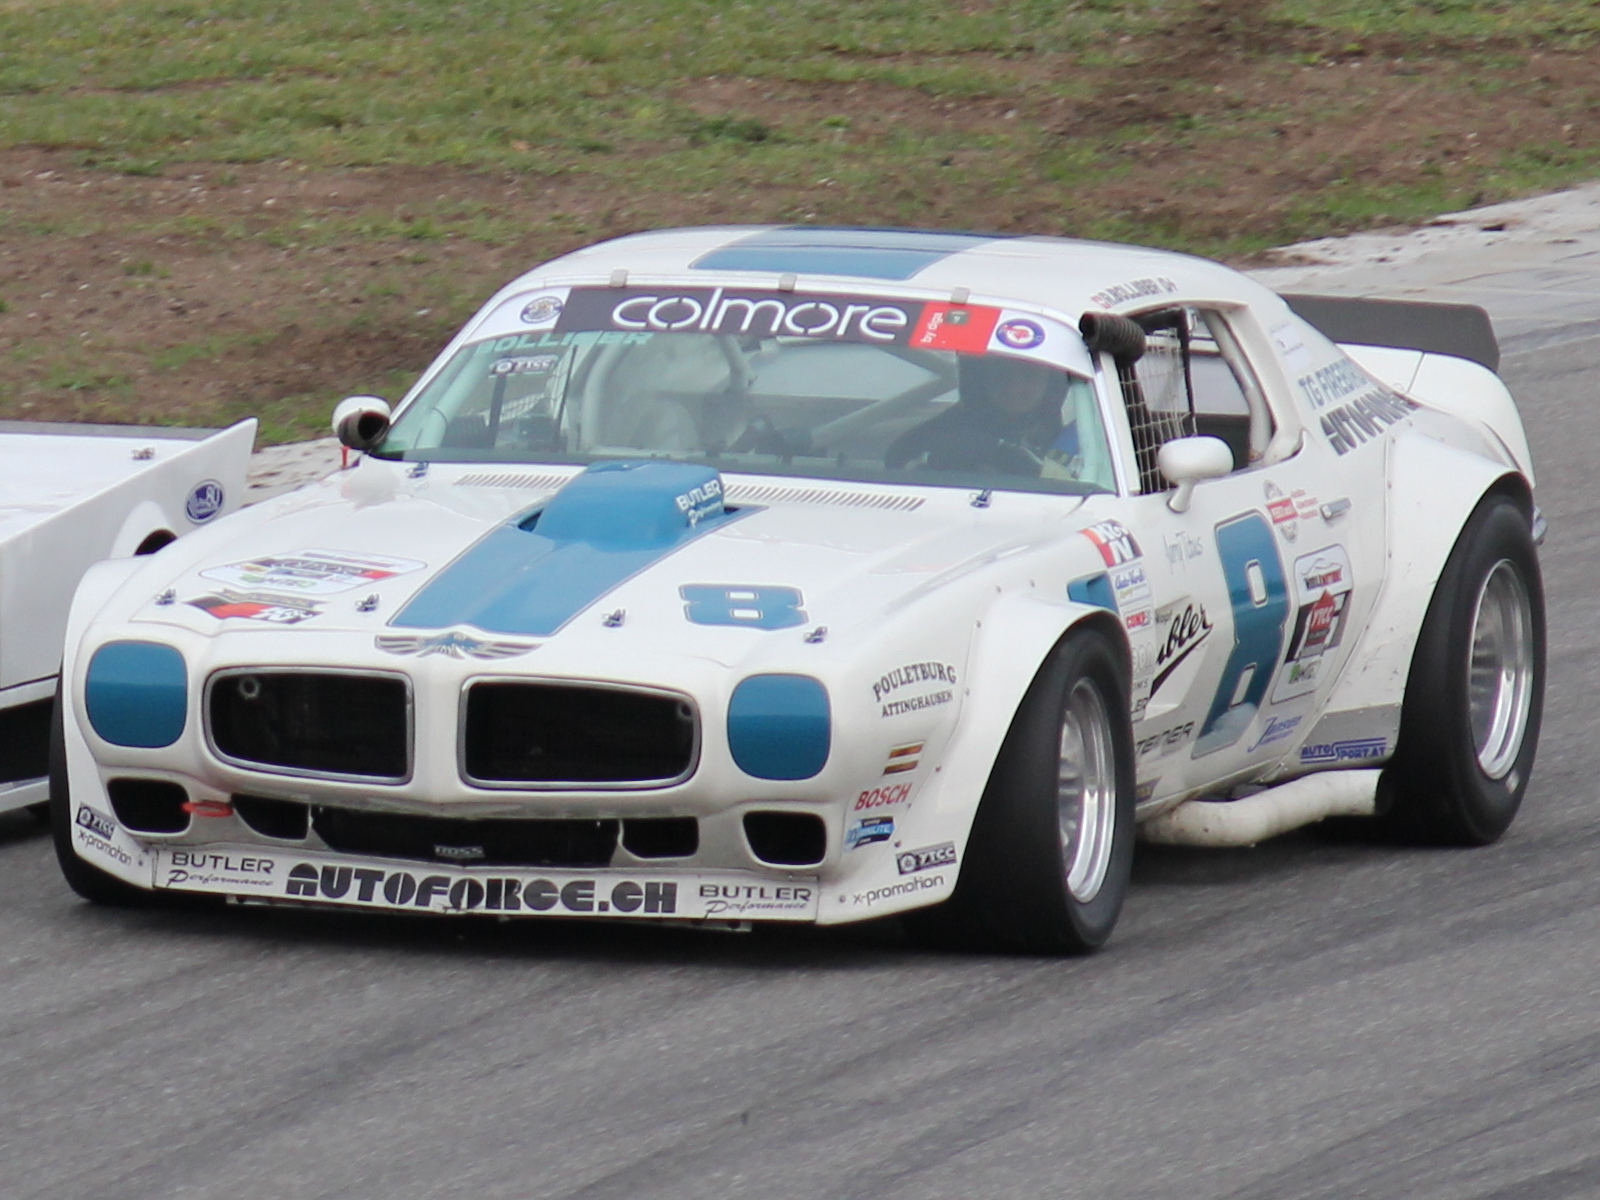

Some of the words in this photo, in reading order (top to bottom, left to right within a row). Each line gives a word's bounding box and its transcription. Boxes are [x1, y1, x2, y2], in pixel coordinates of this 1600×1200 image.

[612, 287, 908, 340] colmore
[675, 479, 722, 511] BUTLER
[678, 583, 810, 631] 8
[1213, 508, 1293, 760] 8
[872, 661, 958, 703] POULETBURG
[881, 690, 954, 719] ATTINGHAUSEN
[854, 782, 914, 811] BOSCH
[78, 829, 132, 866] x-promotion
[171, 851, 275, 874] BUTLER
[166, 868, 275, 888] Performance
[285, 862, 678, 914] AUTOFORCE.CH
[699, 884, 812, 902] BUTLER
[852, 874, 945, 907] x-promotion
[704, 899, 807, 920] Performance
